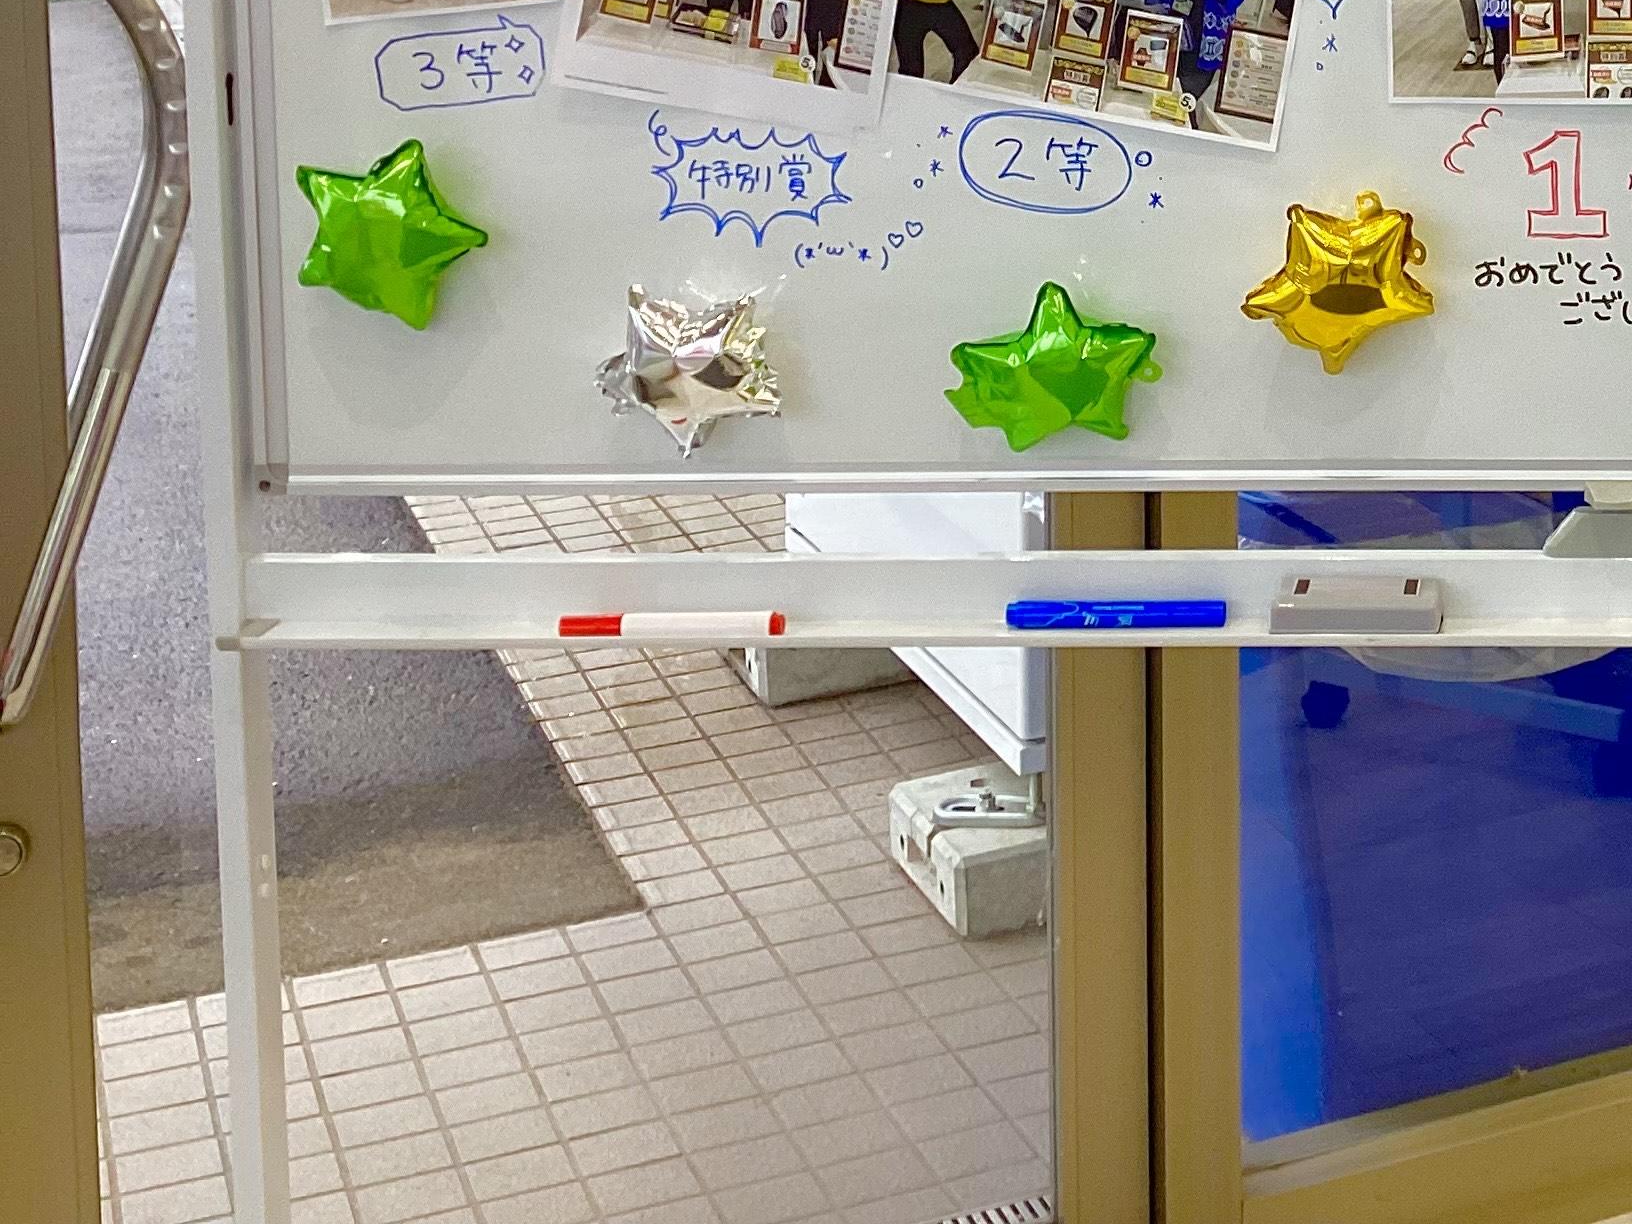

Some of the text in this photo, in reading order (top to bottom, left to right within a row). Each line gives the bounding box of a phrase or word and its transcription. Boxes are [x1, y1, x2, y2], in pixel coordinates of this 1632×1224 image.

[411, 40, 502, 93] 3等
[688, 154, 813, 201] 特別賞
[994, 136, 1100, 191] 2等
[1473, 251, 1623, 288] おめでとう
